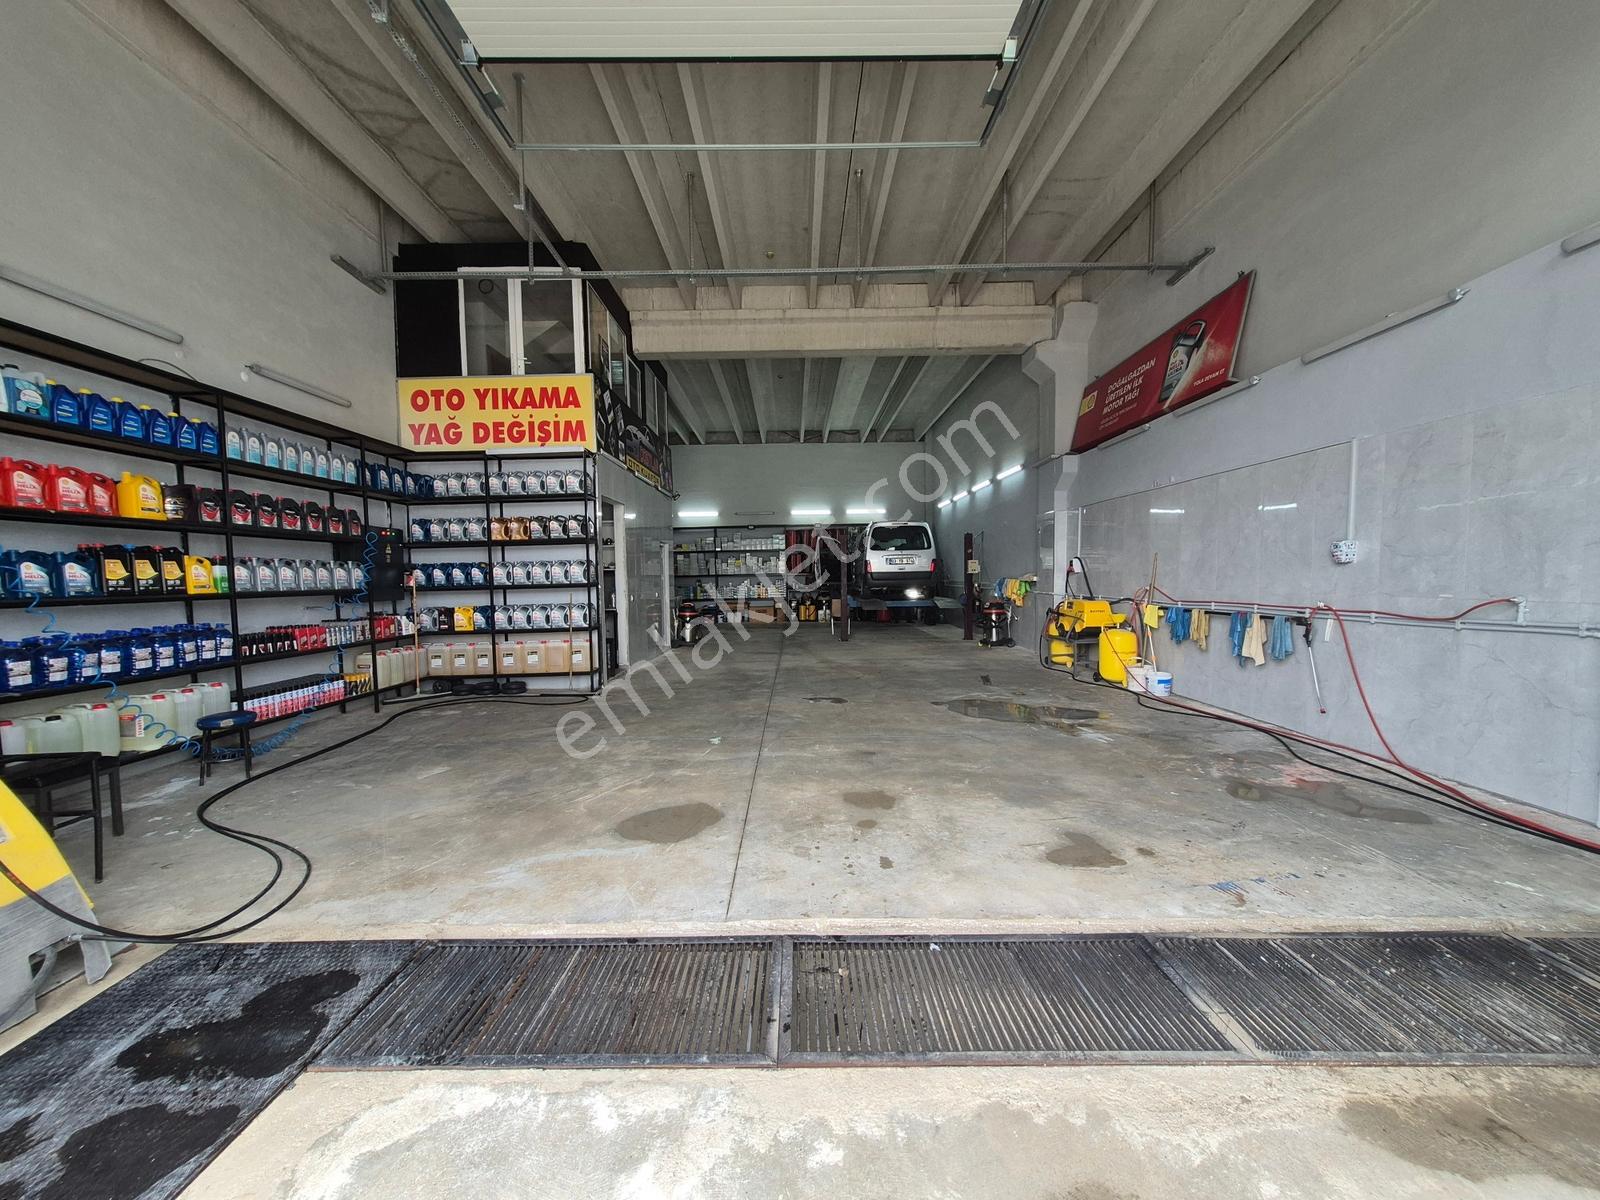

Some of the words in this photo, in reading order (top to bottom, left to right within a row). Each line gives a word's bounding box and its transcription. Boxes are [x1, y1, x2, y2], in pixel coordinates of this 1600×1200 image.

[410, 388, 466, 412] OTO
[472, 386, 582, 410] YIKAMA
[1102, 397, 1124, 415] MOTOR
[408, 415, 463, 446] YAĞ
[472, 413, 587, 447] DEĞİŞİM
